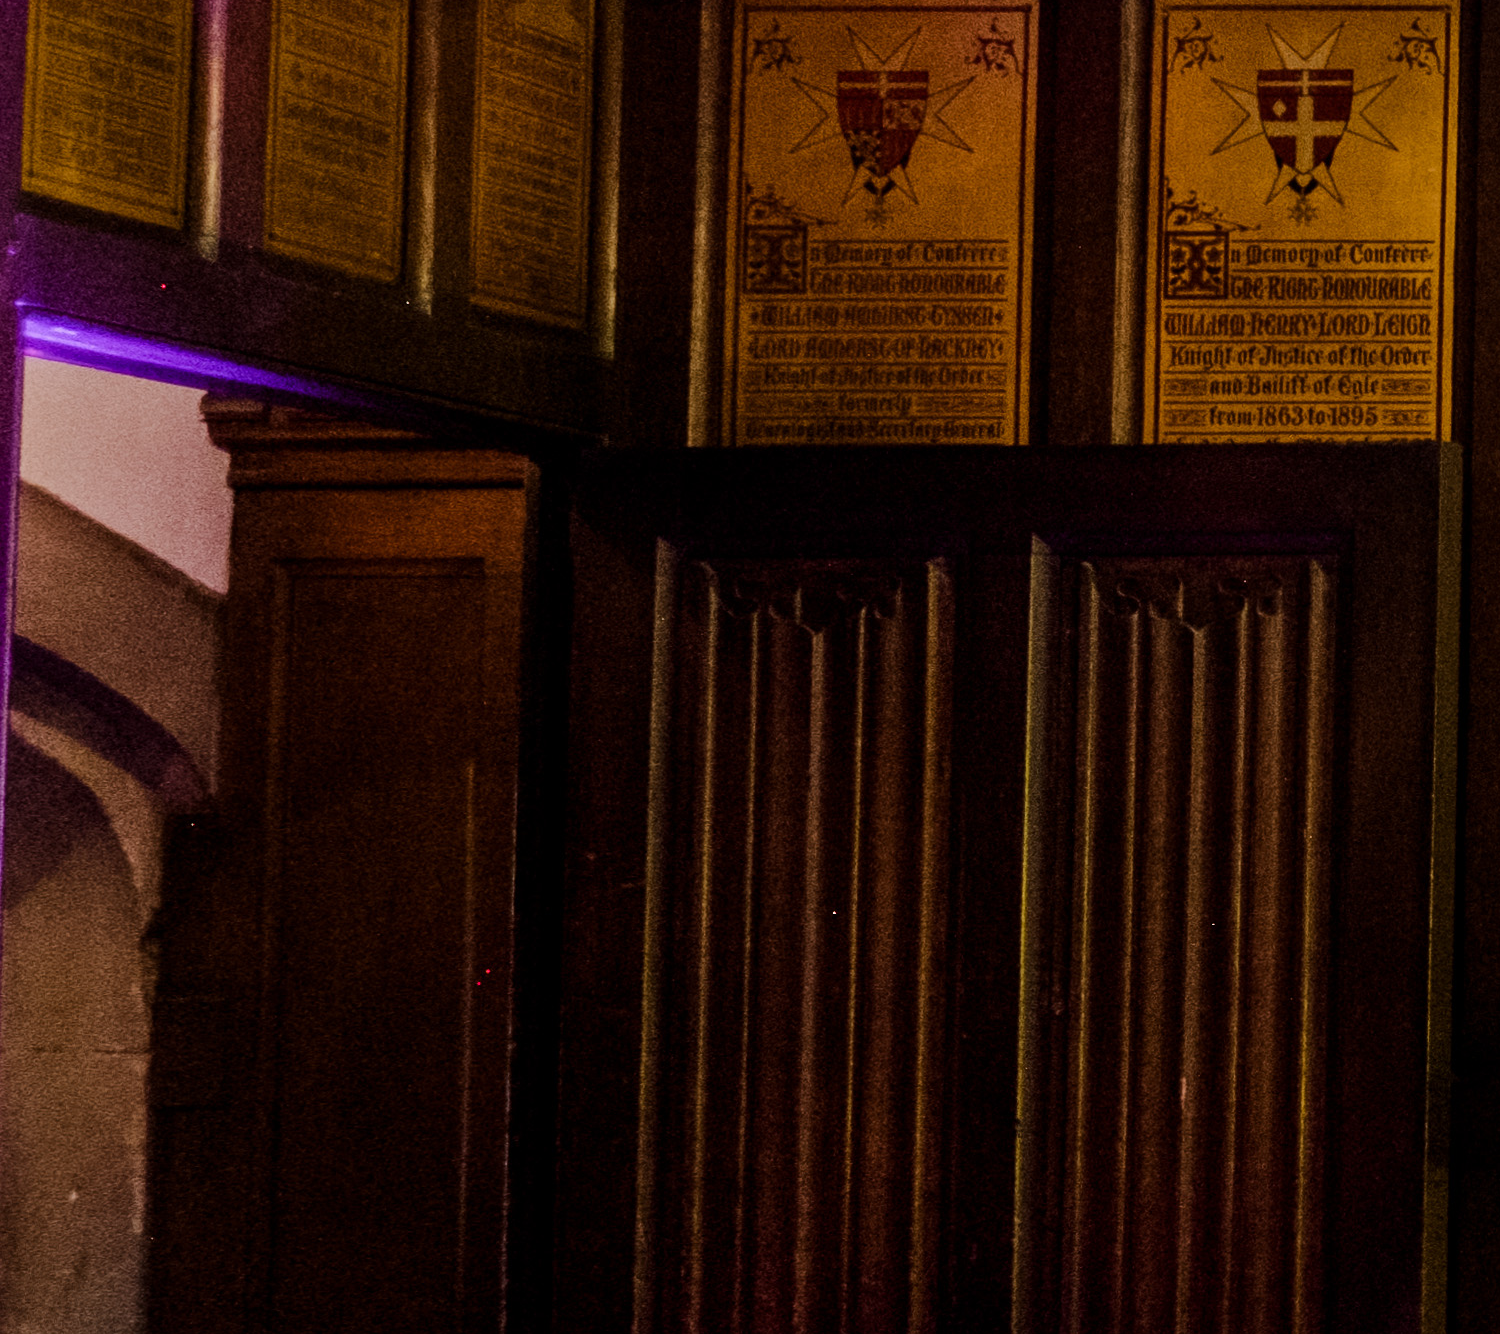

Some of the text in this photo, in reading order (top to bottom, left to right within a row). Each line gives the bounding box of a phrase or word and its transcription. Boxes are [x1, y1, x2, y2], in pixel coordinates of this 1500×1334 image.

[1325, 244, 1342, 264] of
[1170, 346, 1233, 372] Knight
[1238, 346, 1256, 366] of
[1328, 346, 1346, 366] of
[1351, 345, 1376, 368] the
[1381, 346, 1429, 366] Order
[1210, 375, 1242, 395] and
[1313, 375, 1332, 395] of
[1210, 406, 1378, 426] from 1863 to 1895
